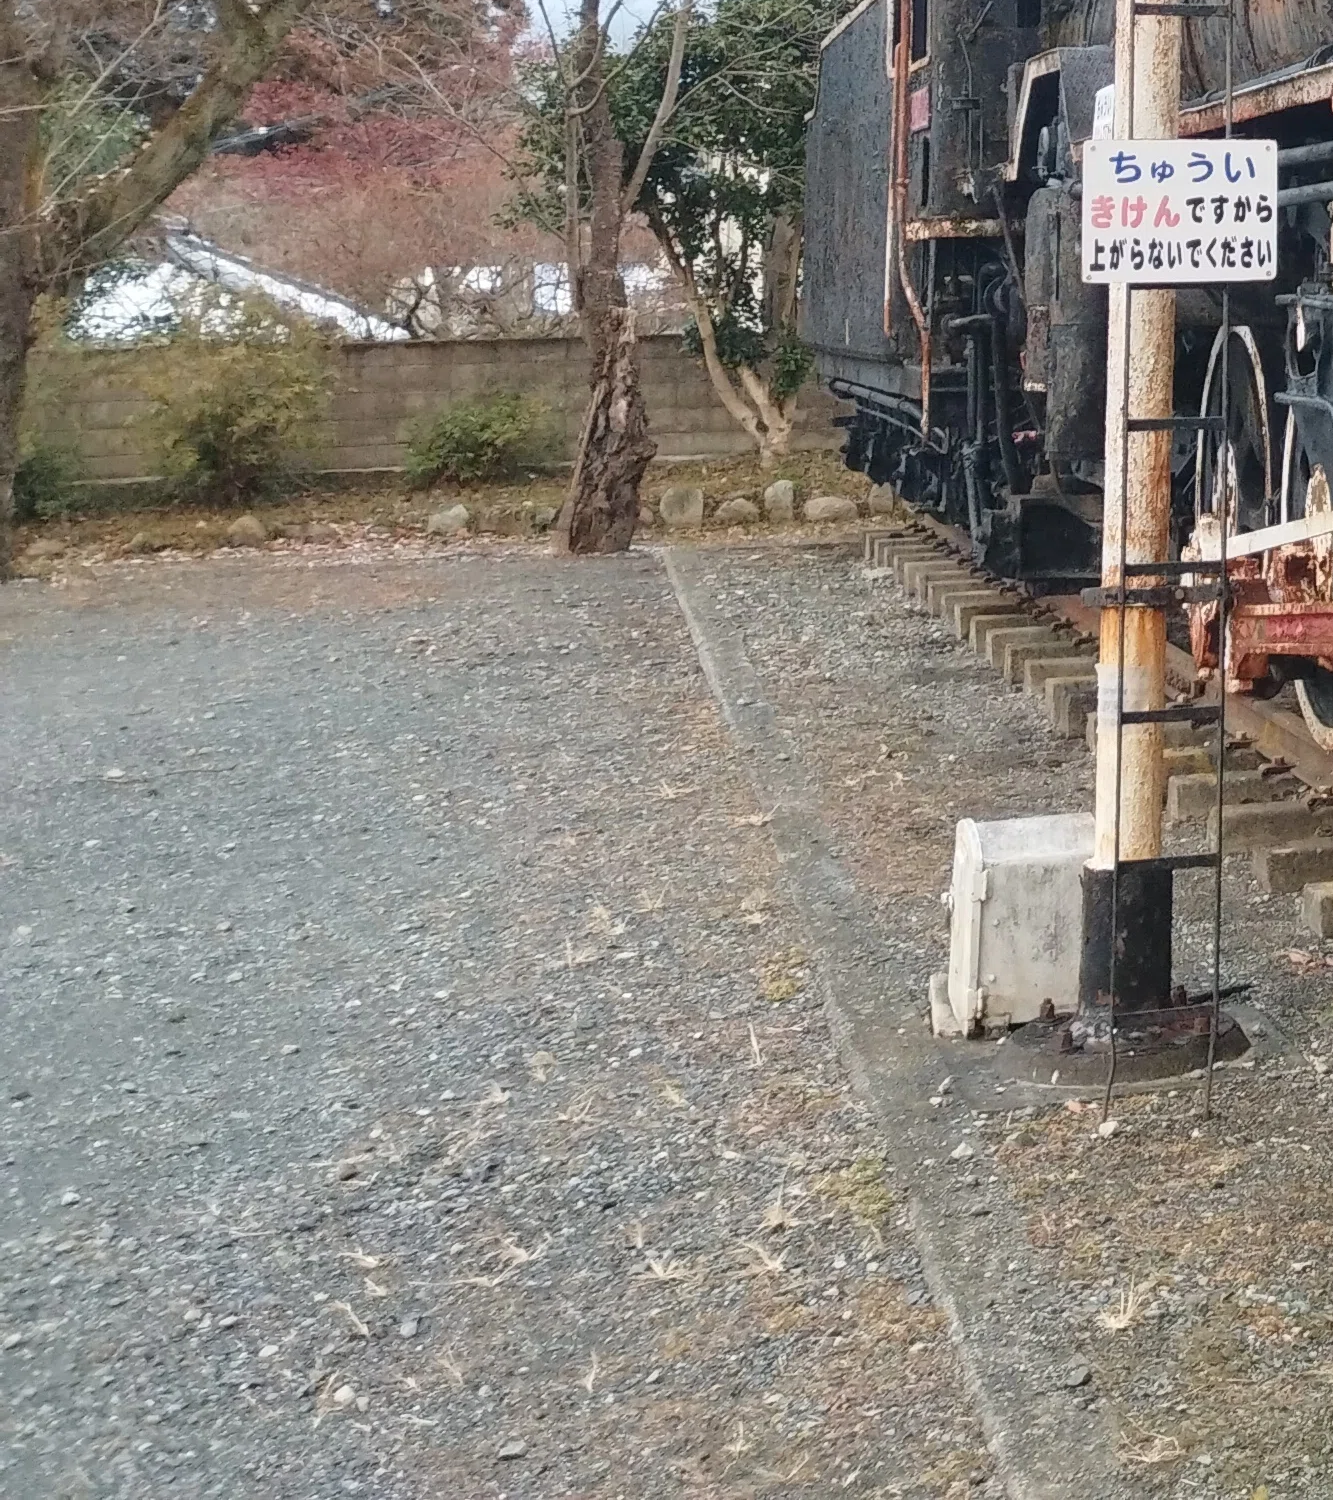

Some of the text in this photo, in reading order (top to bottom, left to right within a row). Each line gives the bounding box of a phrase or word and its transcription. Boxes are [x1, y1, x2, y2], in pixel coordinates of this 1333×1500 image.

[1108, 151, 1256, 183] ちゅうい
[1090, 195, 1273, 228] きけんですから
[1090, 236, 1272, 272] 上がらないでください
